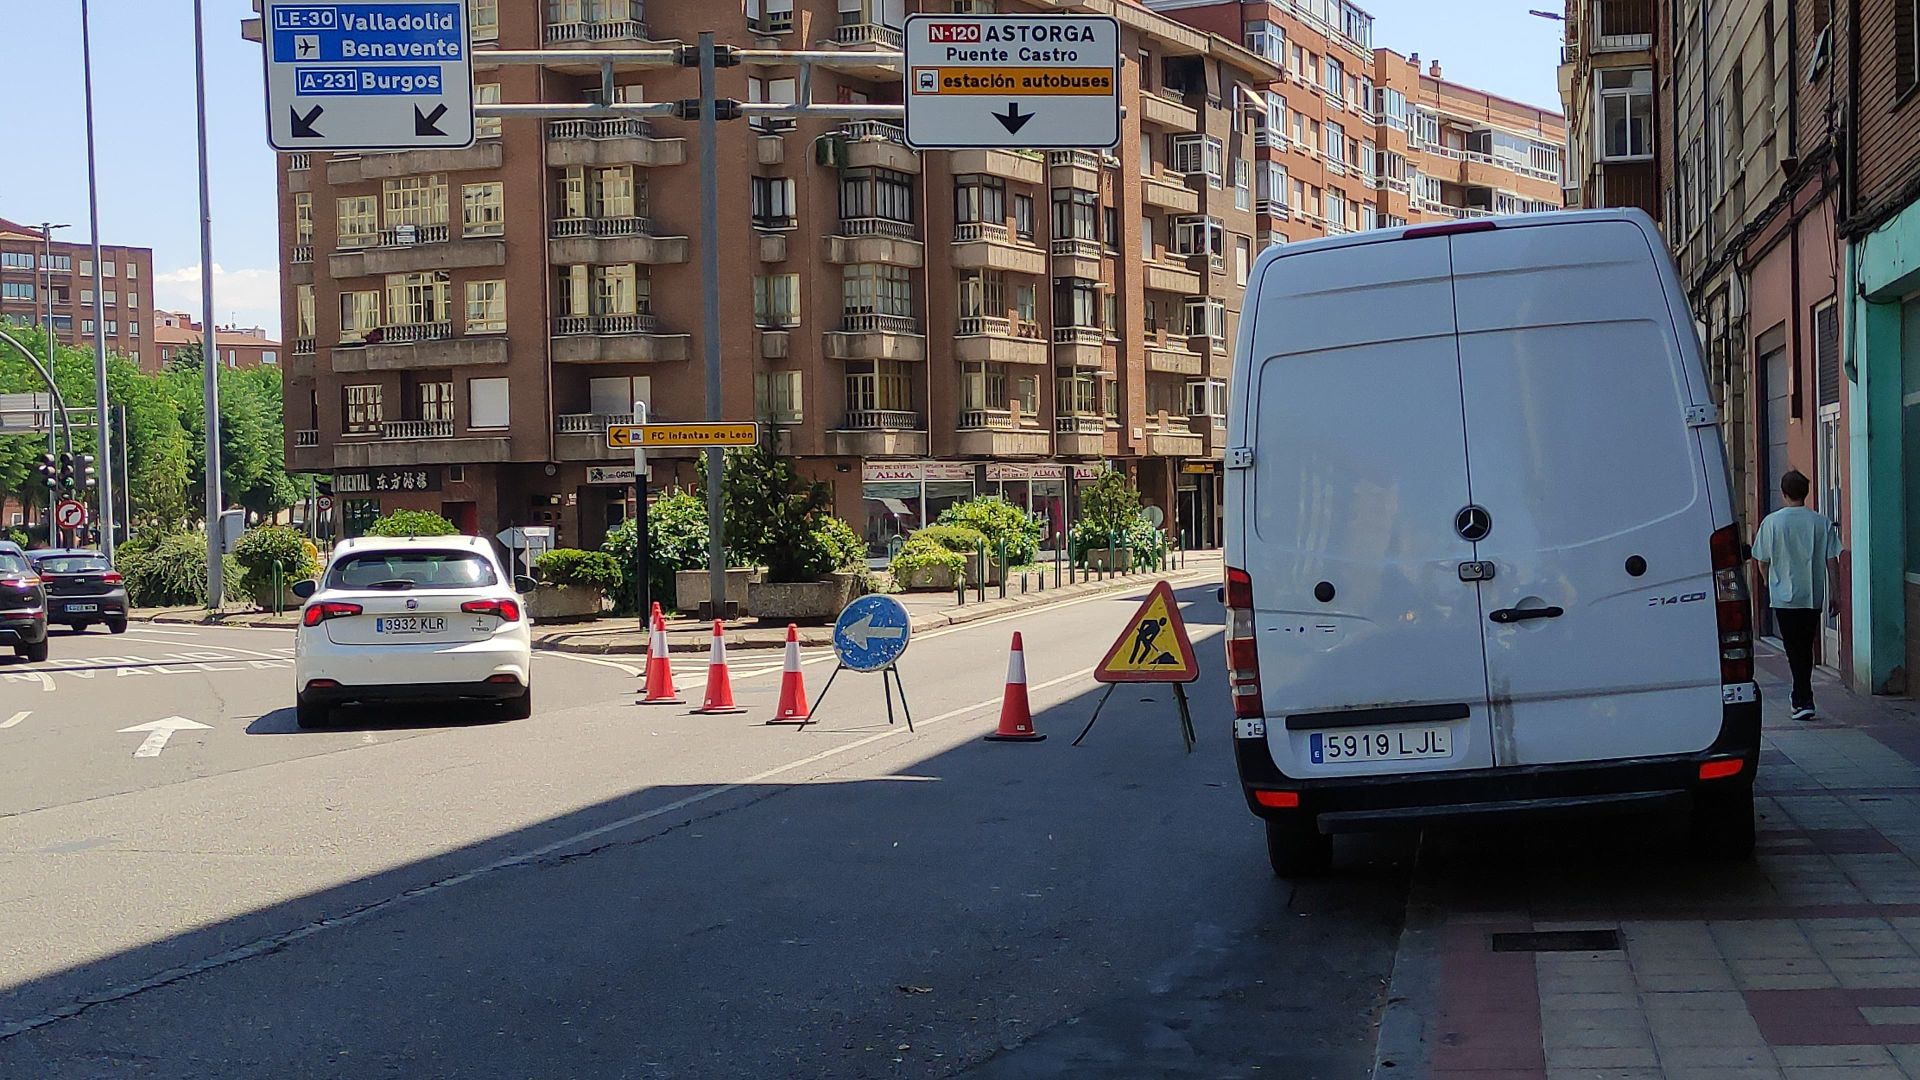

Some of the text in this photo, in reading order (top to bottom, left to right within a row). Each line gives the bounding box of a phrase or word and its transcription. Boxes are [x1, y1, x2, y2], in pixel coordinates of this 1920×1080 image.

[278, 11, 333, 26] LE-30
[341, 13, 453, 31] Valladolid
[931, 27, 979, 40] N-120
[985, 26, 1095, 42] ASTORGA
[342, 39, 459, 57] Benavente
[946, 47, 1078, 61] Puente Castro
[303, 73, 354, 88] A-231
[362, 72, 439, 91] Burgos
[943, 74, 1110, 88] estación autobuses
[651, 431, 665, 440] FC
[669, 430, 709, 440] Infantas
[714, 430, 726, 439] de
[876, 471, 914, 479] ALMA
[1034, 469, 1056, 477] ALMA
[385, 618, 444, 631] 3932 KLR
[1328, 731, 1445, 758] 5919 LJL
